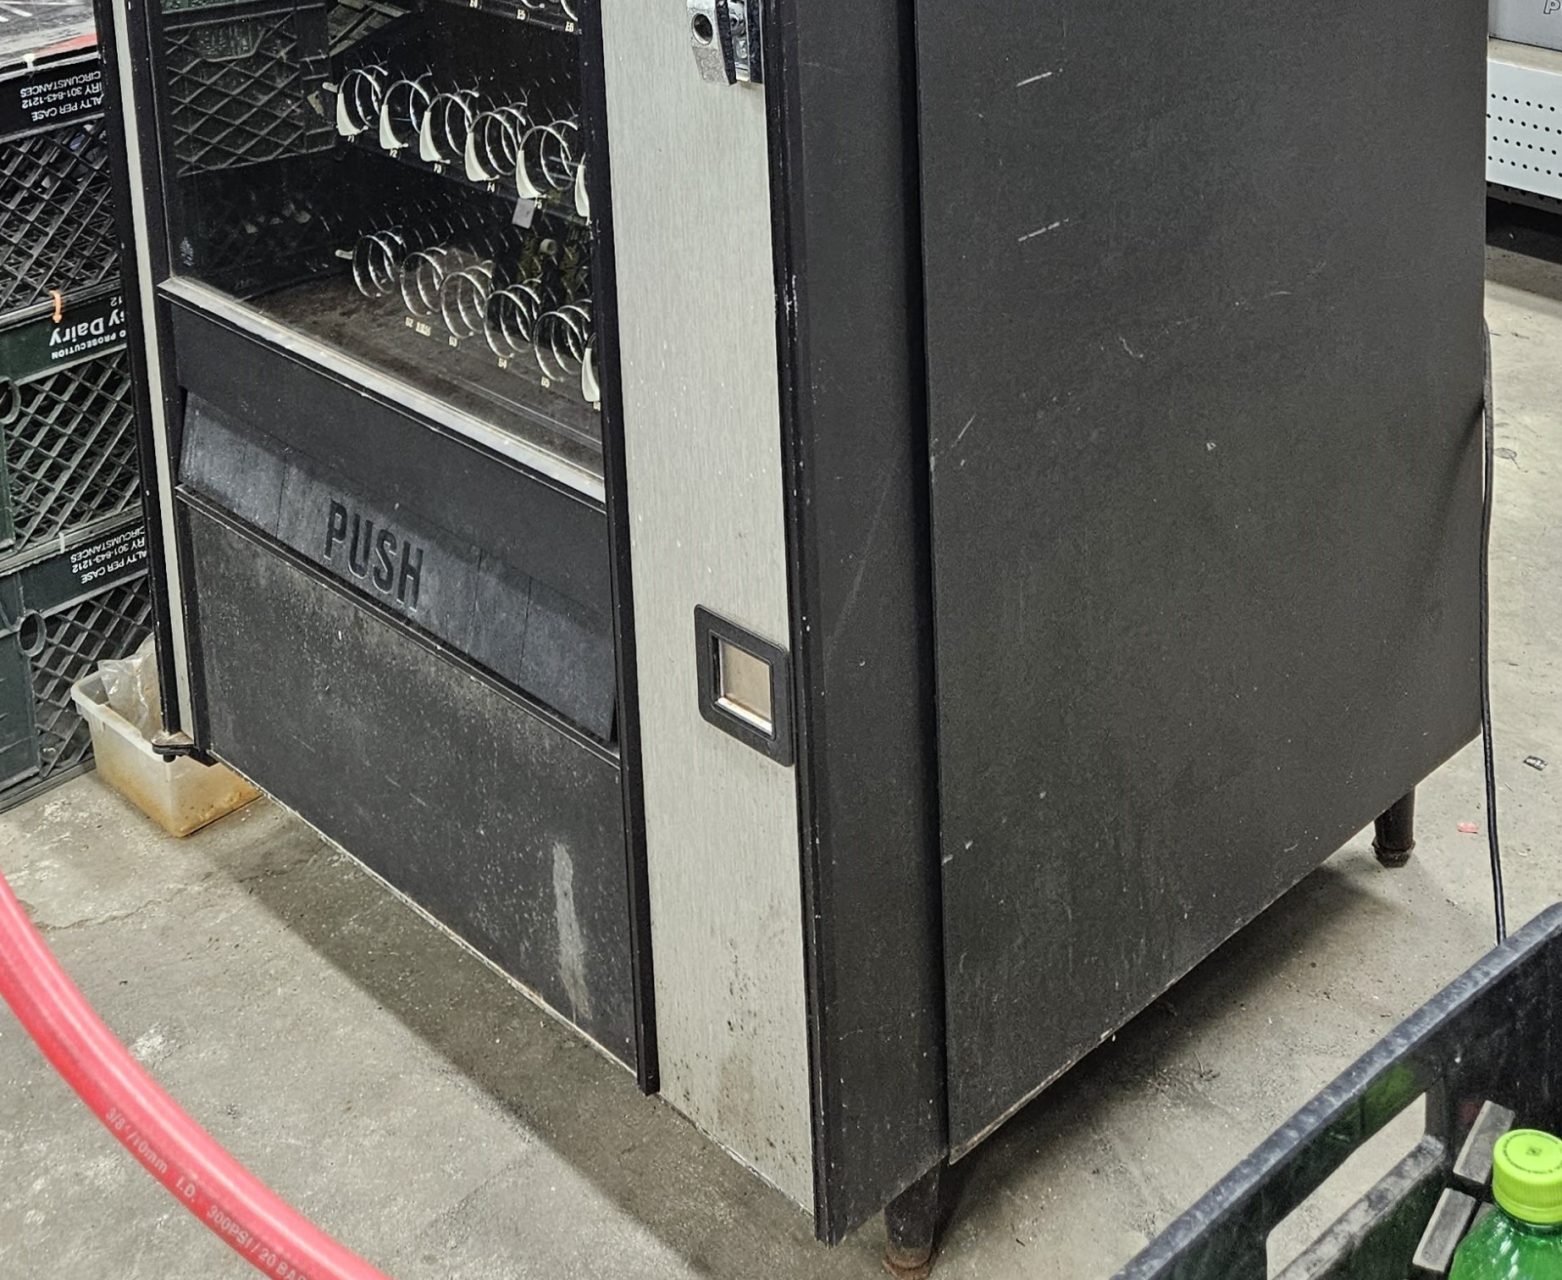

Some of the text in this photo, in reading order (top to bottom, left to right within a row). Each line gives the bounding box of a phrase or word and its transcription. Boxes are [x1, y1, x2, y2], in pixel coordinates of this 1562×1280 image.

[20, 71, 101, 98] CIRCUMSTANCES
[31, 107, 58, 122] CASE
[59, 102, 78, 114] PER
[49, 317, 105, 347] Dairy
[51, 332, 117, 360] PROSECUTION
[106, 558, 125, 572] PER
[323, 498, 424, 613] PUSH
[80, 566, 106, 585] CASE
